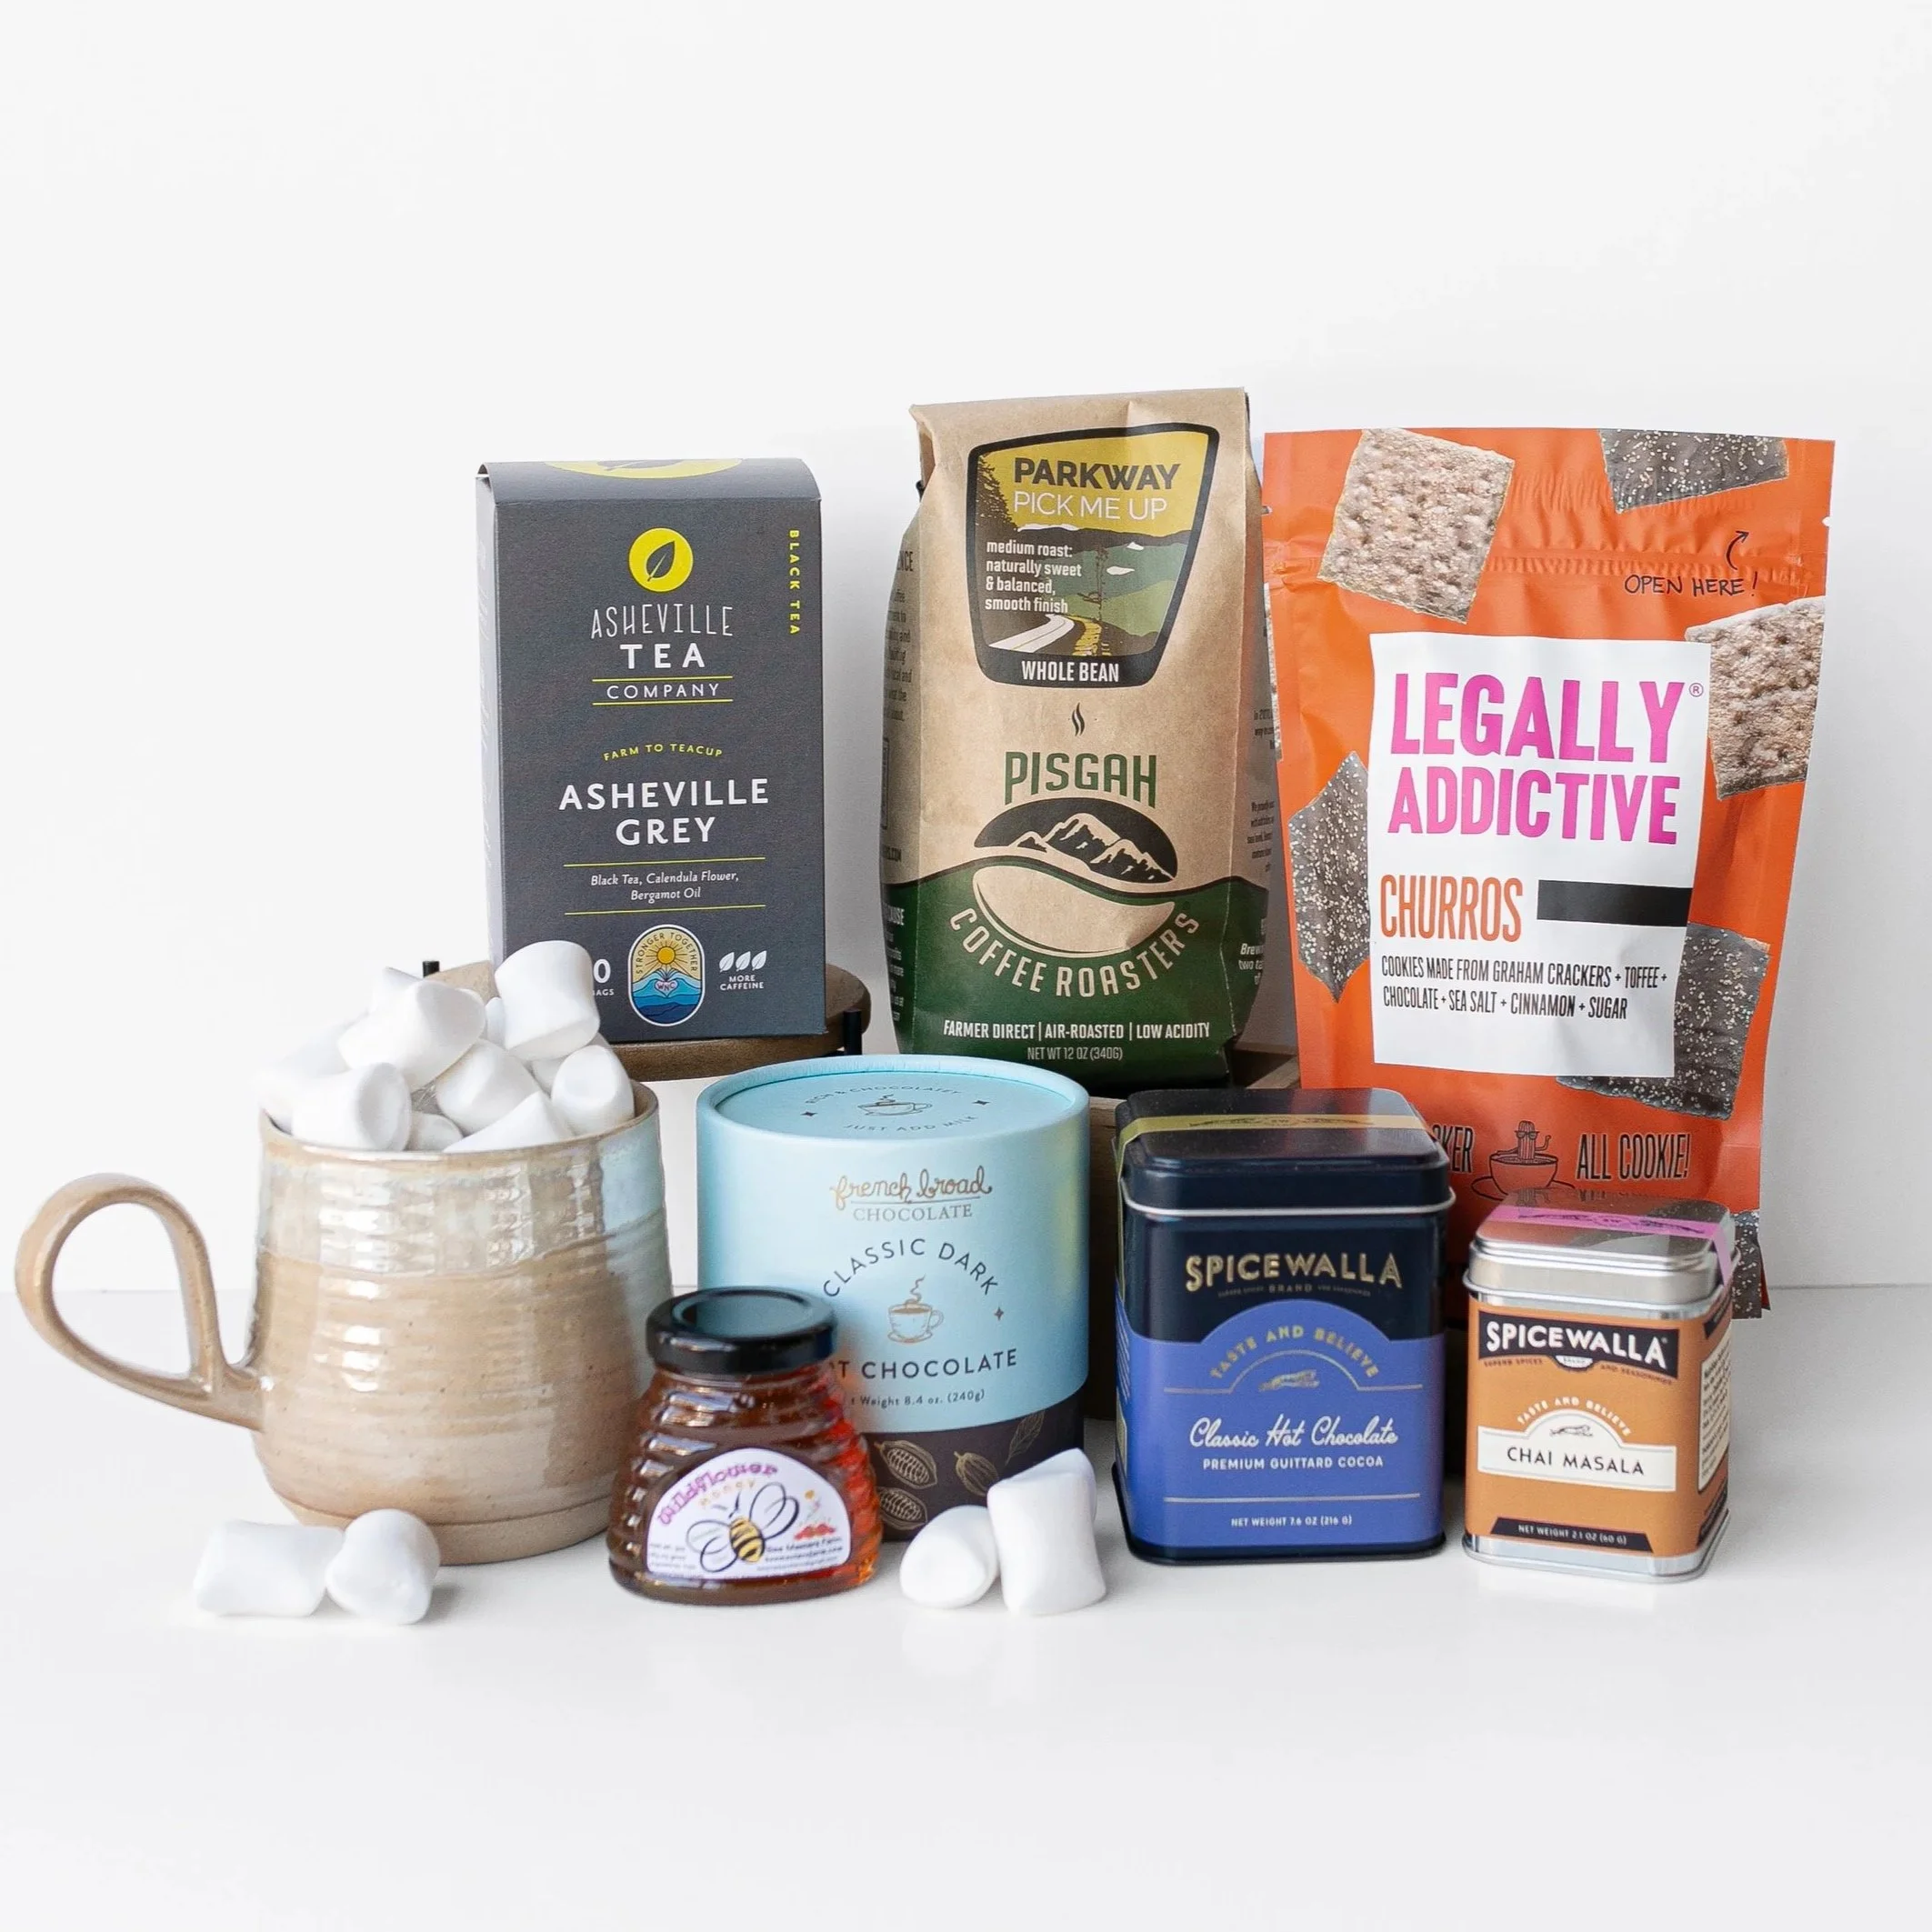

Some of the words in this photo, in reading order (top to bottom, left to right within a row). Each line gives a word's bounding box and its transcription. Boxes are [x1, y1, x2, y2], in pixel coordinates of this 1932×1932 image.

[1015, 457, 1180, 490] PARKWAY
[1014, 490, 1074, 516] PICK
[1081, 496, 1120, 520] ME
[1129, 497, 1167, 521] UP
[789, 529, 800, 590] BLACK
[986, 539, 1035, 556] medium
[1037, 545, 1073, 558] roast:
[986, 559, 1042, 577] naturally
[1044, 564, 1082, 577] sweet
[986, 576, 994, 591] &
[996, 576, 1056, 596] balanced,
[1624, 573, 1683, 596] OPEN
[789, 600, 800, 635] TEA
[985, 596, 1031, 611] smooth
[1034, 597, 1068, 613] finish
[590, 603, 734, 640] ASHEVILLE
[619, 643, 705, 670] TEA
[1021, 660, 1074, 682] WHOLE
[1078, 662, 1119, 683] BEAN
[606, 683, 720, 700] COMPANY
[603, 746, 639, 762] FARM
[645, 743, 664, 753] TO
[669, 743, 723, 757] TEACUP
[1005, 751, 1157, 809] PISGAH
[558, 778, 769, 811] ASHEVILLE
[1387, 766, 1681, 846] ADDICTIVE
[616, 816, 716, 846] GREY
[591, 874, 619, 886] Black
[622, 874, 643, 886] Tea,
[646, 871, 698, 885] Calendula
[701, 869, 739, 883] Flower,
[630, 889, 680, 904] Bergamot
[684, 886, 701, 899] Oil
[1379, 874, 1524, 943] CHURROS
[636, 933, 666, 975] STRONGER
[670, 933, 698, 972] TOGETHER
[949, 908, 1048, 994] COFFEE
[1056, 913, 1200, 997] ROASTERS
[1237, 959, 1255, 971] two
[593, 958, 611, 984] 0
[728, 975, 756, 983] MORE
[1381, 955, 1425, 978] COOKIES
[1426, 957, 1454, 980] MADE
[1457, 958, 1489, 982] FROM
[1493, 960, 1544, 985] GRAHAM
[1547, 963, 1612, 988] CRACKERS
[1625, 966, 1660, 989] TOFFEE
[657, 982, 676, 991] WNC
[719, 982, 765, 991] CAFFEINE
[1383, 986, 1439, 1010] CHOCOLATE
[1448, 989, 1467, 1012] SEA
[1469, 991, 1497, 1014] SALT
[1510, 993, 1577, 1017] CINNAMON
[1587, 996, 1628, 1020] SUGAR
[943, 1019, 990, 1038] FARMER
[993, 1023, 1036, 1039] DIRECT
[1045, 1023, 1125, 1039] AIR-ROASTED
[1136, 1024, 1163, 1039] LOW
[1165, 1022, 1210, 1039] ACIDITY
[1027, 1046, 1046, 1059] NET
[1046, 1046, 1063, 1060] WT
[1064, 1046, 1074, 1060] 12
[1076, 1046, 1088, 1060] OZ
[1089, 1046, 1124, 1061] (340G)
[844, 1124, 886, 1132] JUST
[942, 1115, 978, 1127] MILK
[1576, 1133, 1612, 1180] ALL
[1618, 1133, 1691, 1180] COOKIE!
[829, 1172, 913, 1211] french
[916, 1165, 993, 1199] broad
[853, 1204, 973, 1222] CHOCOLATE
[823, 1237, 926, 1298] CLASSIC
[938, 1242, 999, 1296] DARK
[1185, 1252, 1403, 1293] SPICEWALLA
[1268, 1284, 1313, 1294] BRAND
[1209, 1336, 1257, 1379] TASTE
[1266, 1325, 1305, 1343] AND
[1313, 1327, 1379, 1378] BELIEVE
[1486, 1320, 1668, 1370] SPICEWALLA
[861, 1348, 1017, 1380] CHOCOLATE
[859, 1395, 899, 1409] Weight
[904, 1395, 923, 1406] 8.4
[947, 1388, 986, 1403] (240g)
[1517, 1399, 1549, 1426] TASTE
[1554, 1396, 1580, 1406] AND
[1586, 1400, 1632, 1436] BELIEVE
[1189, 1416, 1259, 1447] Classic
[1265, 1413, 1306, 1447] Hot
[1310, 1415, 1398, 1446] Chocolate
[1203, 1457, 1265, 1470] PREMIUM
[1270, 1457, 1333, 1469] GUITTARD
[1337, 1456, 1384, 1468] COCOA
[1507, 1446, 1553, 1466] CHAI
[1563, 1453, 1645, 1476] MASALA
[1230, 1517, 1248, 1527] NET
[1251, 1517, 1287, 1527] WEIGHT
[1305, 1516, 1317, 1527] OZ
[1517, 1524, 1535, 1534] NET
[1537, 1527, 1569, 1538] WEIGHT
[1585, 1532, 1597, 1542] OZ
